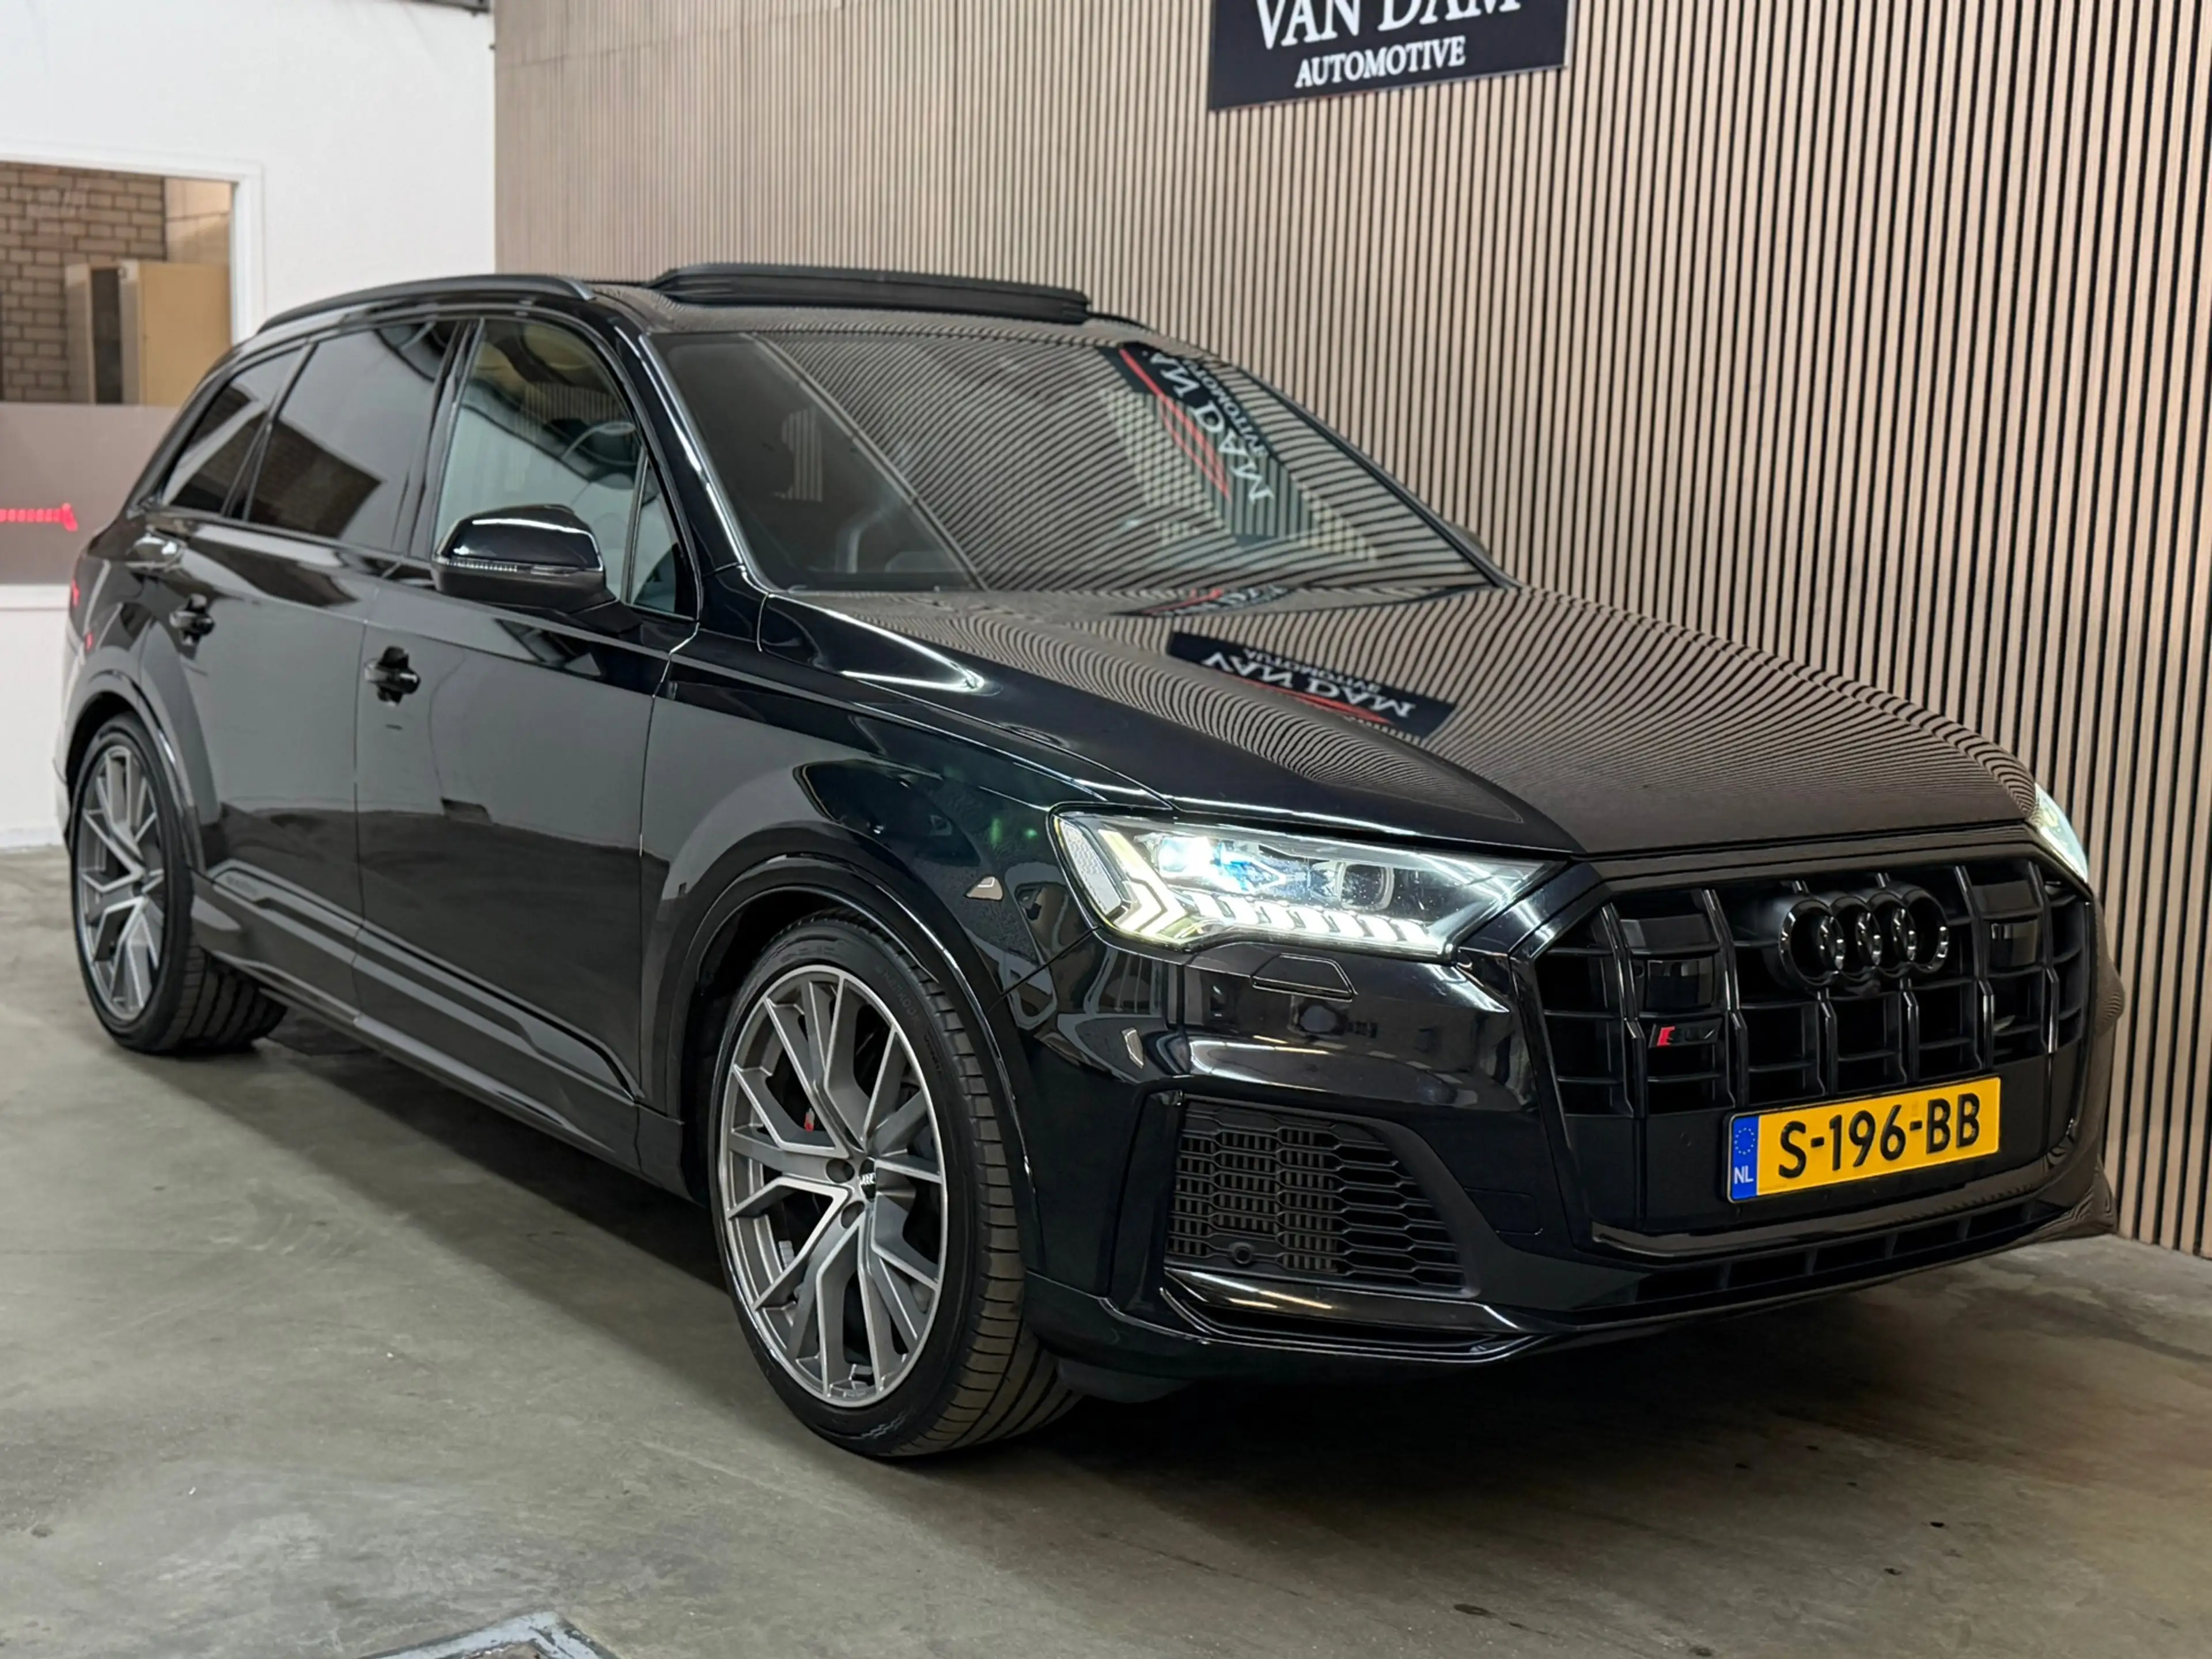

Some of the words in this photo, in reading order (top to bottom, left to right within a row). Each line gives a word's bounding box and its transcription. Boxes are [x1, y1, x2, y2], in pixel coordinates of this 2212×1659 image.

[1256, 0, 1361, 50] VAN
[1294, 35, 1466, 88] AUTOMOTIVE
[1778, 1093, 1980, 1179] S-196-BB
[1734, 1164, 1755, 1184] NL
